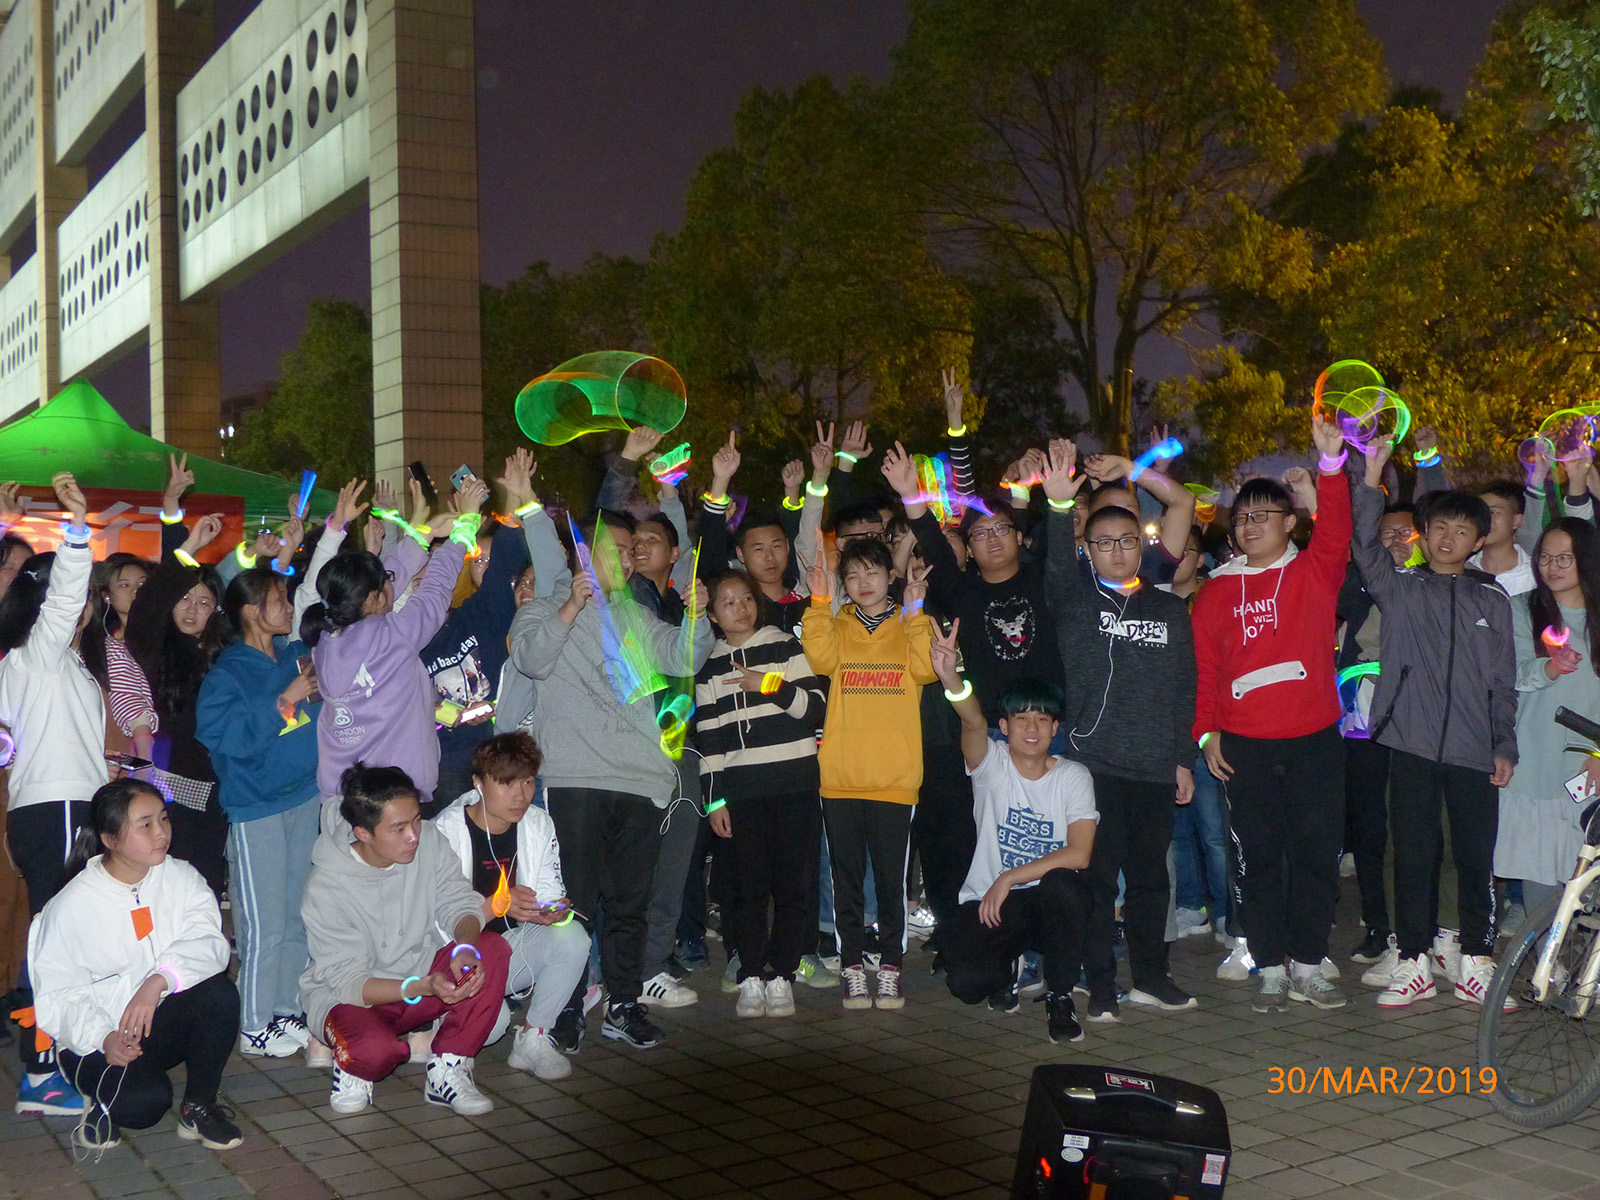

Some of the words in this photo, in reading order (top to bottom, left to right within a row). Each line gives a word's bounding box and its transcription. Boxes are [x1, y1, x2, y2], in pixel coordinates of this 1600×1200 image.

[437, 651, 464, 668] back
[460, 635, 479, 653] day
[334, 726, 366, 737] ONDON
[339, 735, 362, 745] PARIS
